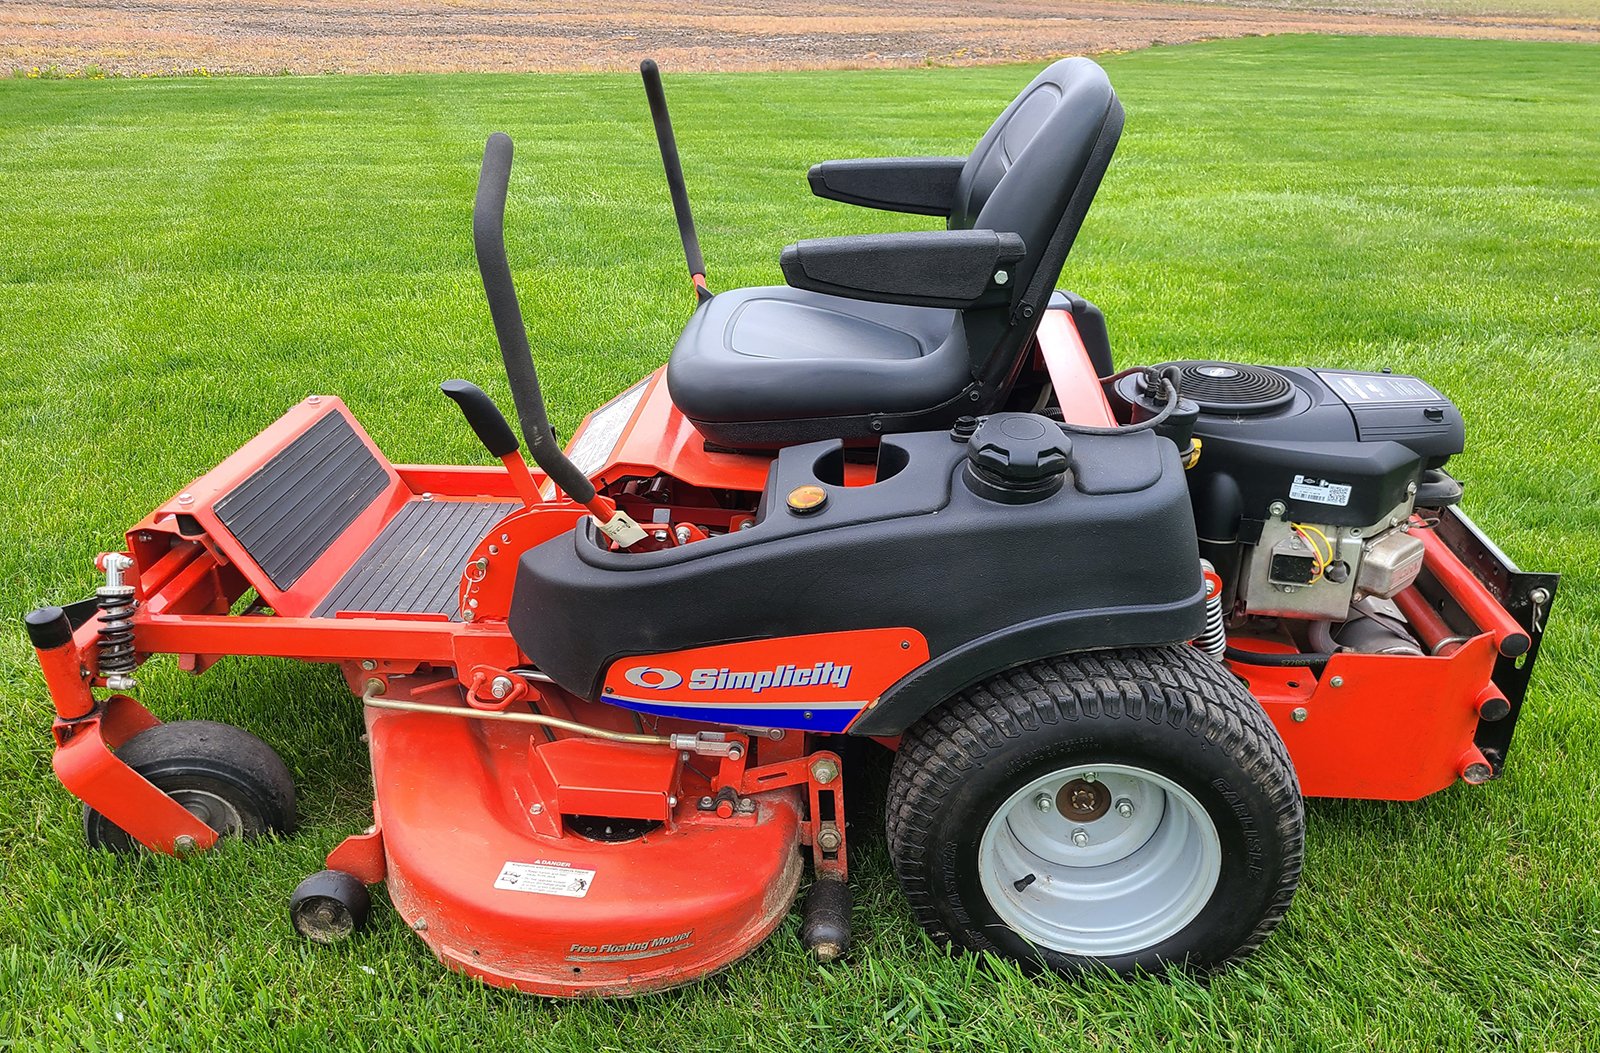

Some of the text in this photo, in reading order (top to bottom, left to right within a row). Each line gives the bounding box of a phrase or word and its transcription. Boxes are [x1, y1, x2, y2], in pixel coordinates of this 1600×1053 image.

[688, 661, 853, 693] Simplicity
[541, 859, 571, 868] DANGER
[569, 930, 693, 953] Free Floating Mower
